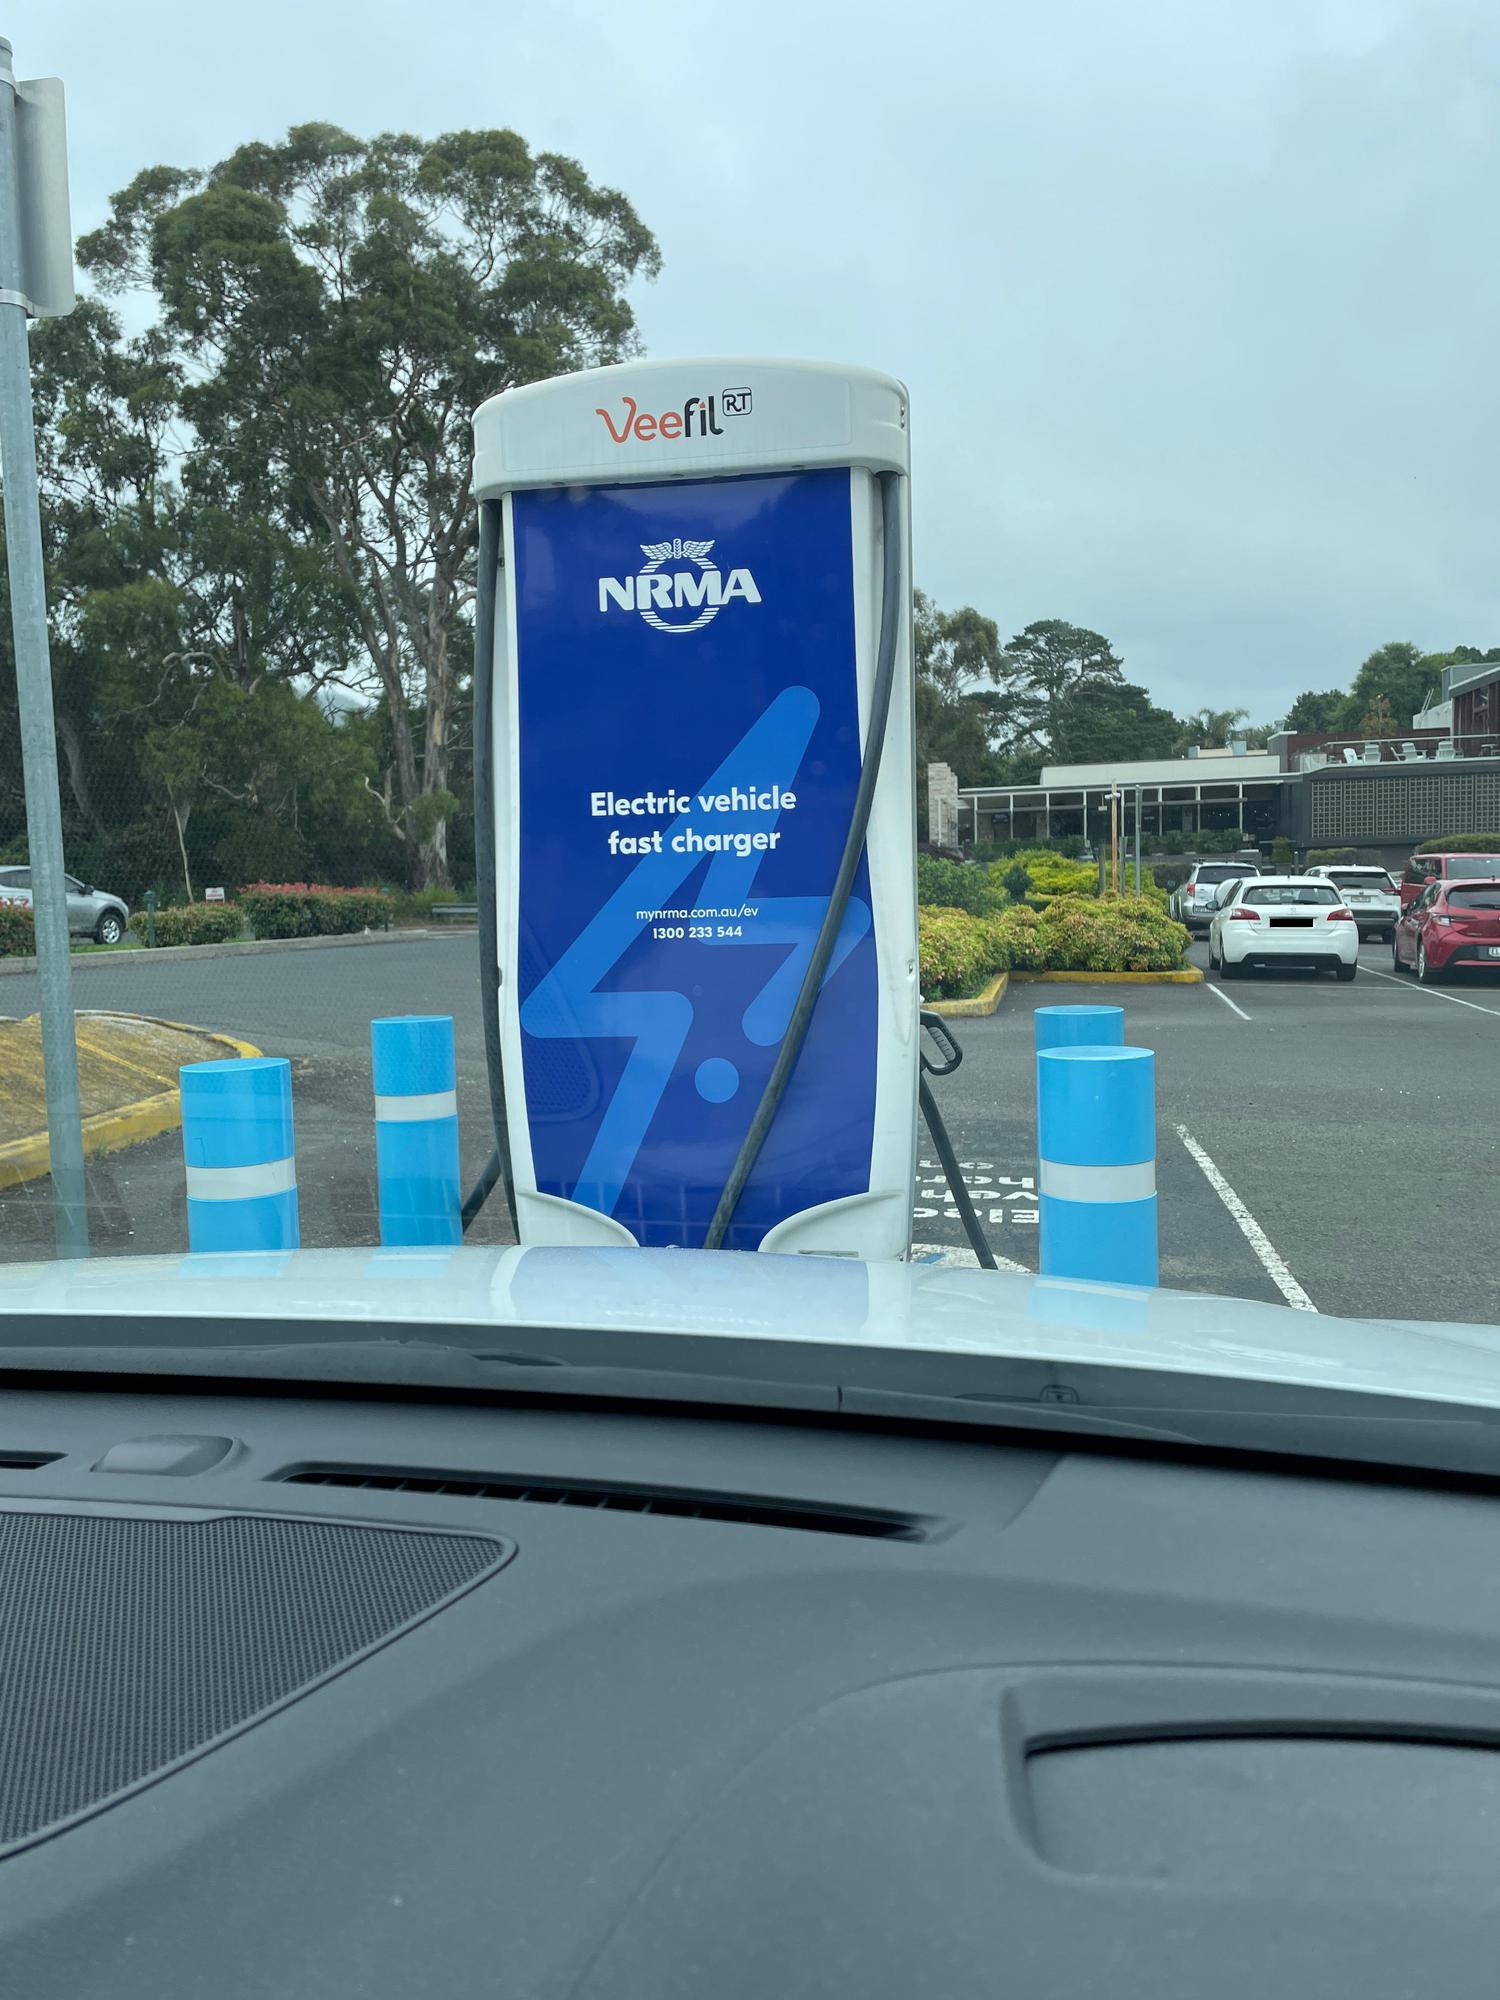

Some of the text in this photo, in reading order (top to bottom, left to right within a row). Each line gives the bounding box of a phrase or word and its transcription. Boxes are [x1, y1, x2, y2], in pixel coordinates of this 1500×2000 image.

[595, 392, 751, 443] Veefil RT
[598, 569, 762, 612] NRMA
[591, 785, 797, 816] Electric vehicle
[608, 828, 781, 857] fast charger
[636, 904, 758, 922] mynrma.com.au/ev
[653, 926, 742, 939] 1300 233 544
